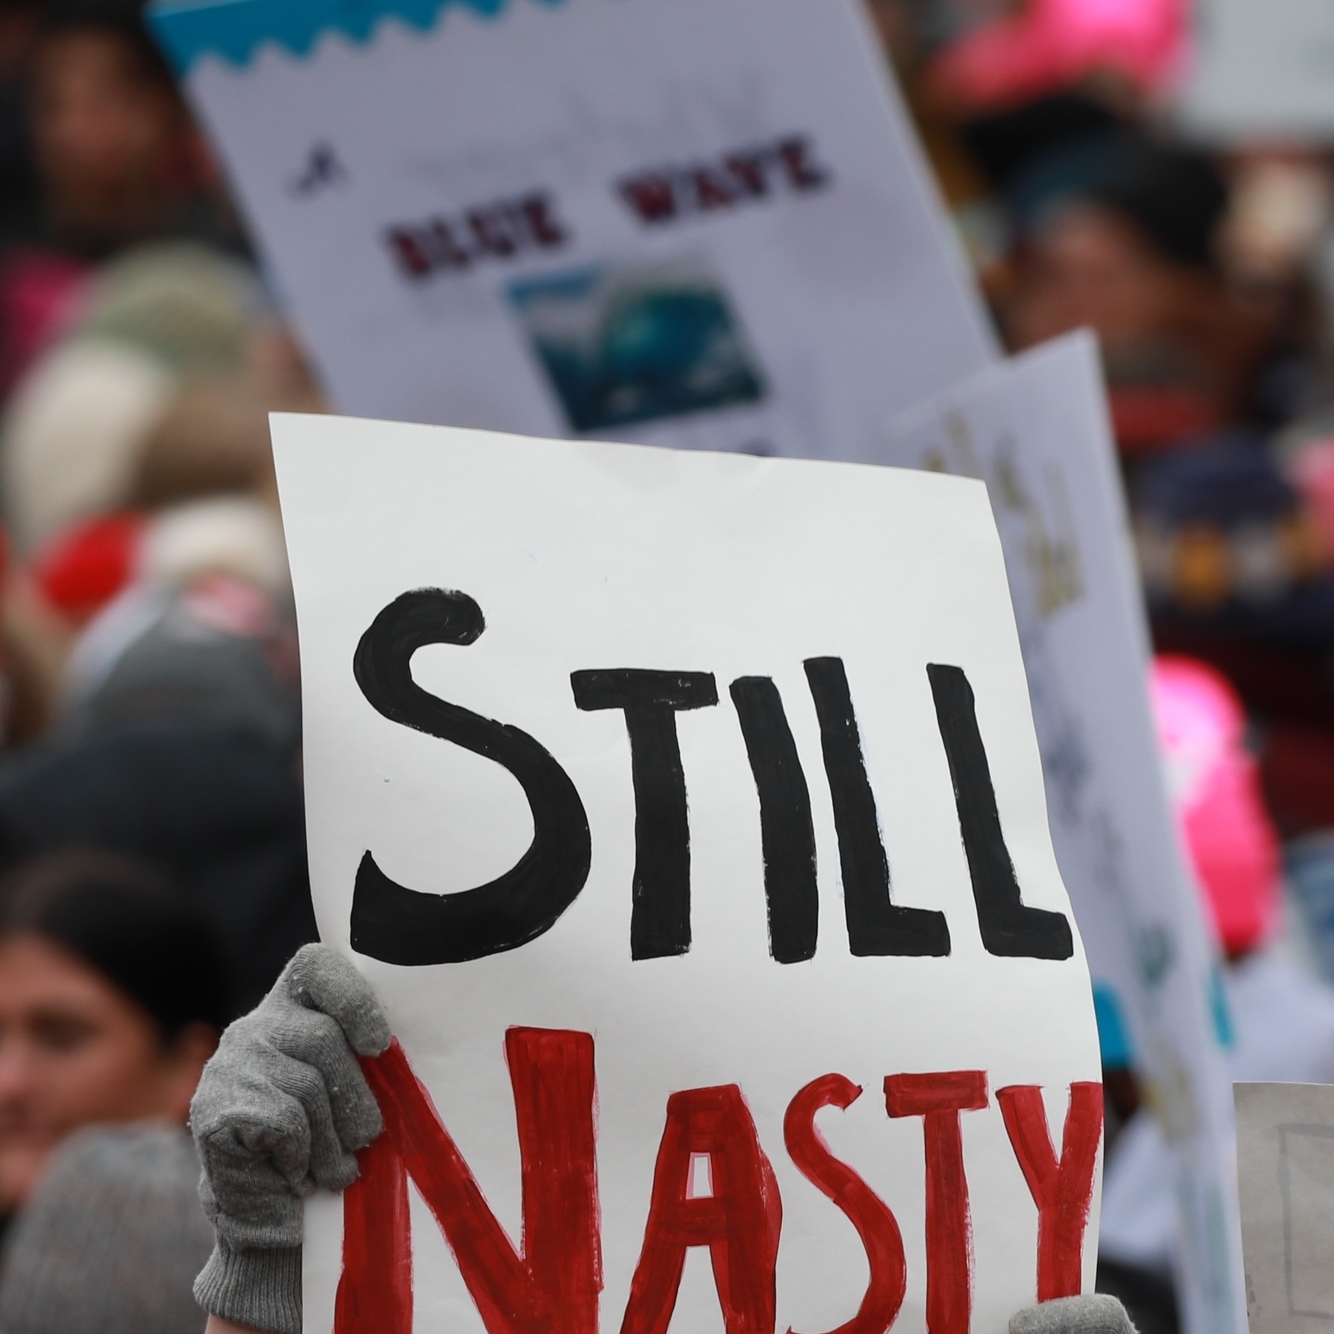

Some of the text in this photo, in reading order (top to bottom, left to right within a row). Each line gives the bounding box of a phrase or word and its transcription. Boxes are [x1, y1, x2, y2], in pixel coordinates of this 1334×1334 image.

[384, 133, 830, 283] BLUE WAVE
[351, 586, 1074, 966] STILL
